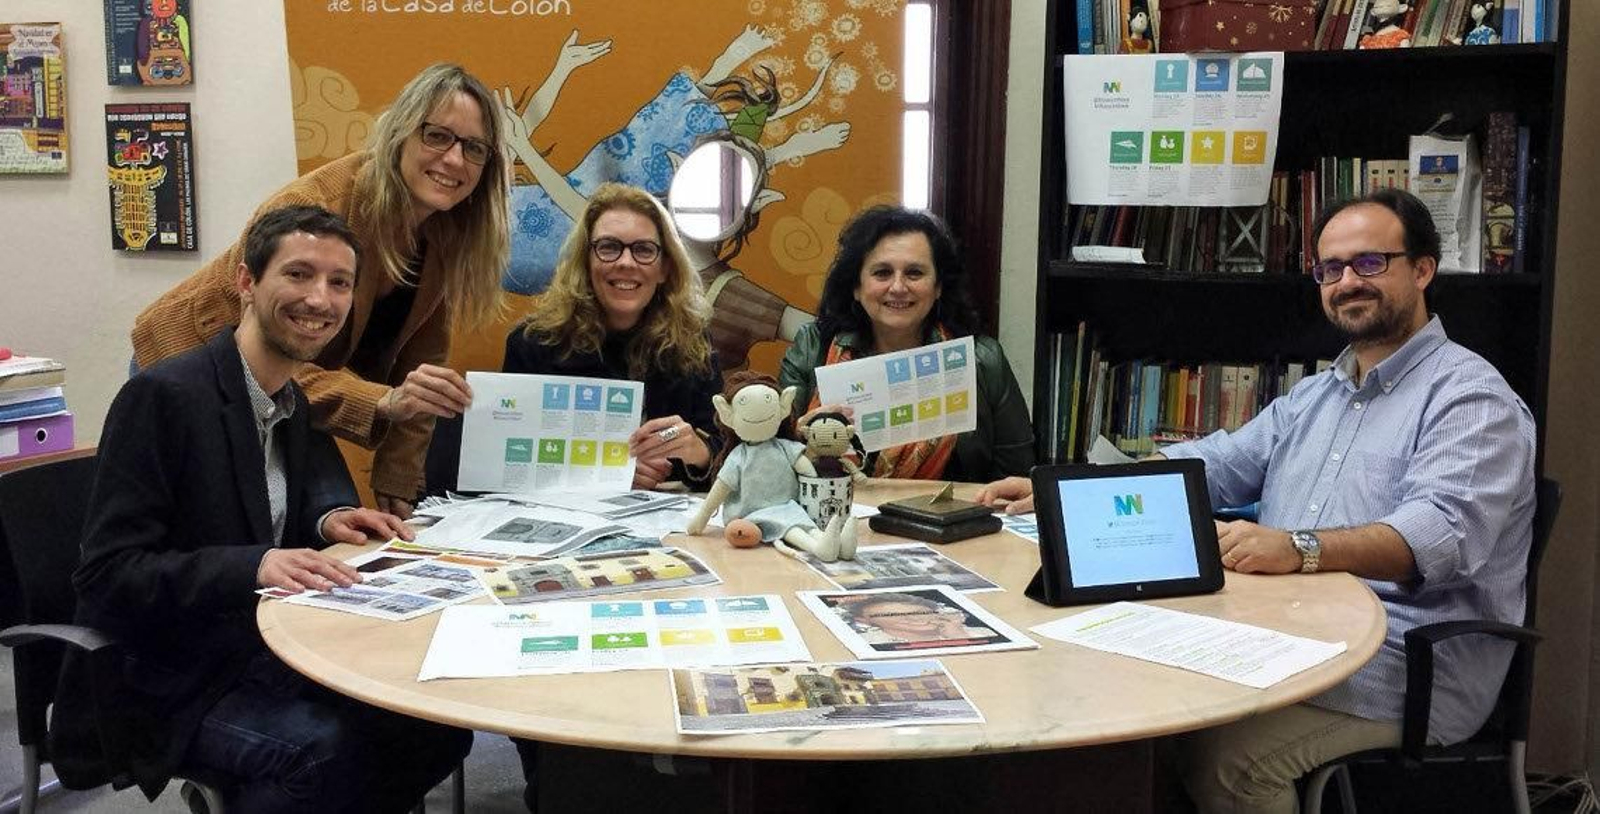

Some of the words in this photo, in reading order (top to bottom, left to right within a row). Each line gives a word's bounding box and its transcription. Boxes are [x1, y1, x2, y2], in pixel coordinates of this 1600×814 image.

[327, 0, 353, 12] de
[362, 0, 377, 12] la
[462, 0, 486, 13] de
